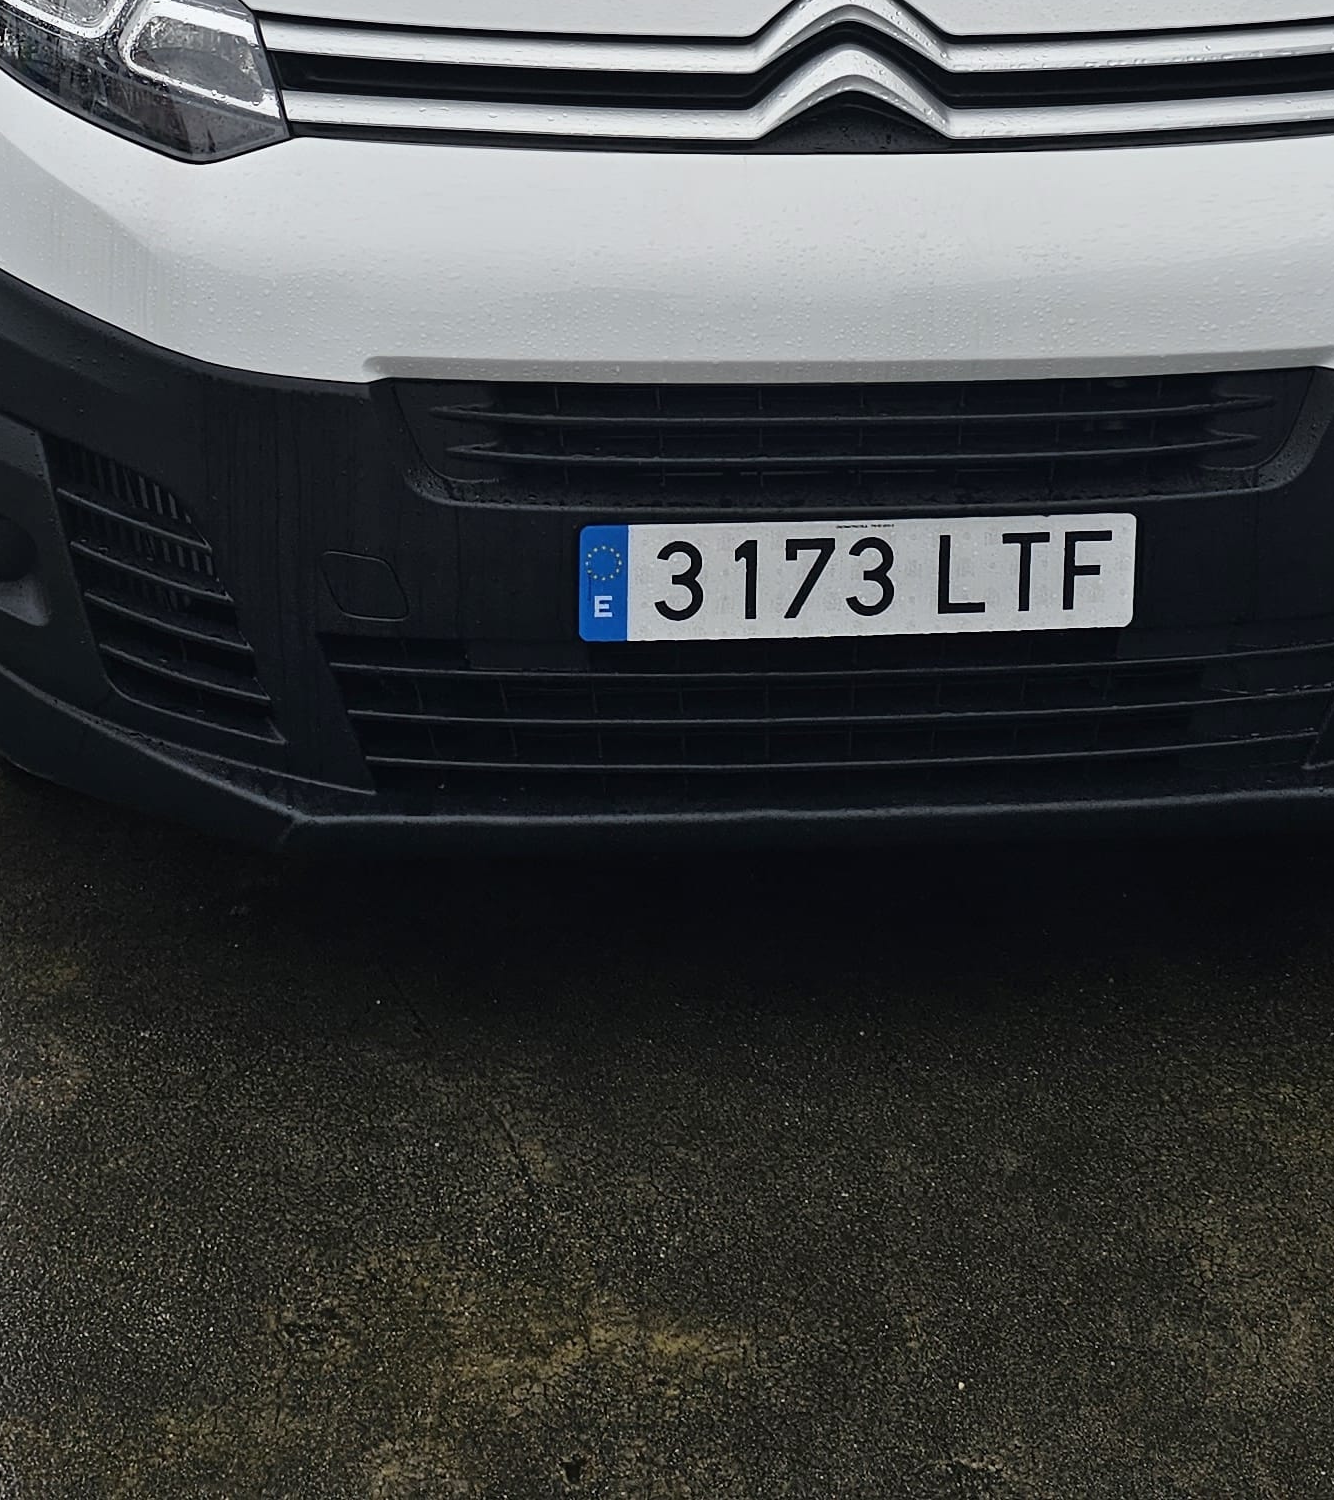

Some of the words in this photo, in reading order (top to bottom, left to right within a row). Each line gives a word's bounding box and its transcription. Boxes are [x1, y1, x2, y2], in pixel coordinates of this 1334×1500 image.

[654, 536, 895, 621] 3173
[937, 530, 1113, 615] LTF
[594, 595, 613, 618] E
